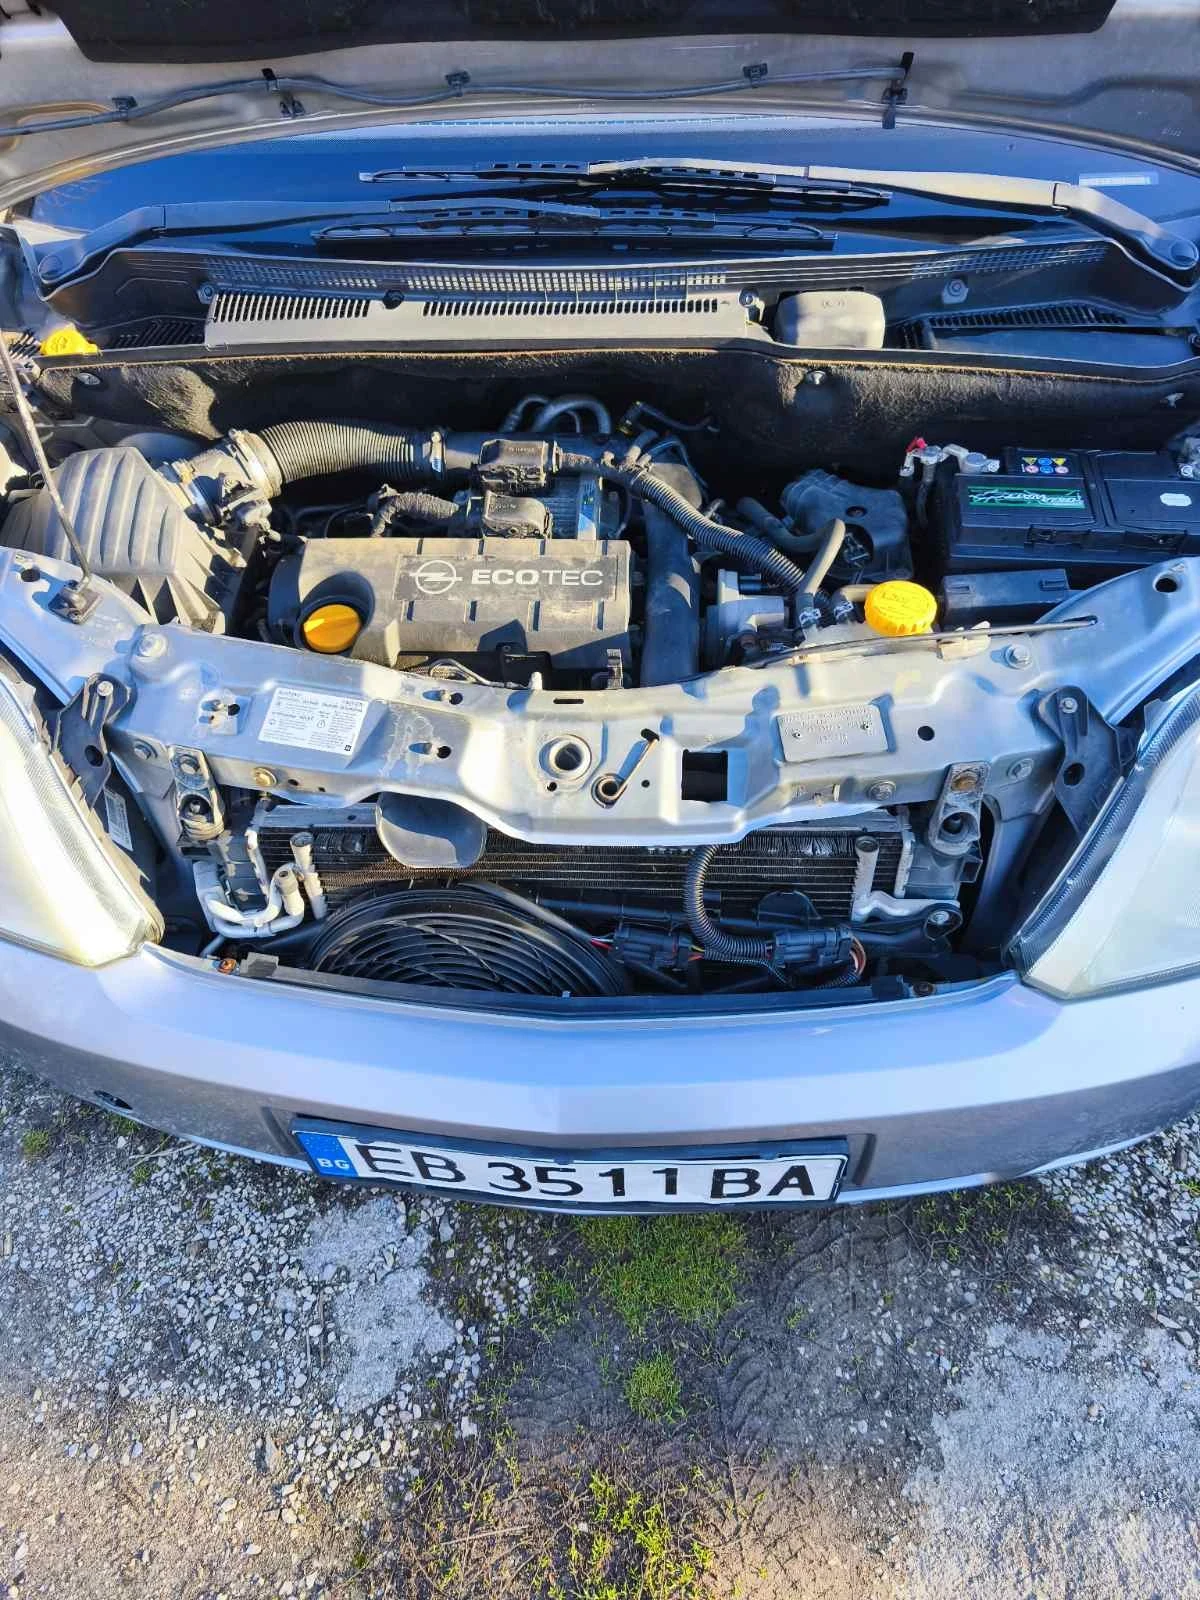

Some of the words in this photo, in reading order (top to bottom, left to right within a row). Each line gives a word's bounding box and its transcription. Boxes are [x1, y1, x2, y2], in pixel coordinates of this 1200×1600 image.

[471, 568, 604, 587] ECOTEC
[317, 1157, 350, 1169] BG
[355, 1144, 466, 1183] EB
[487, 1161, 679, 1197] 3511
[710, 1164, 815, 1199] BA
